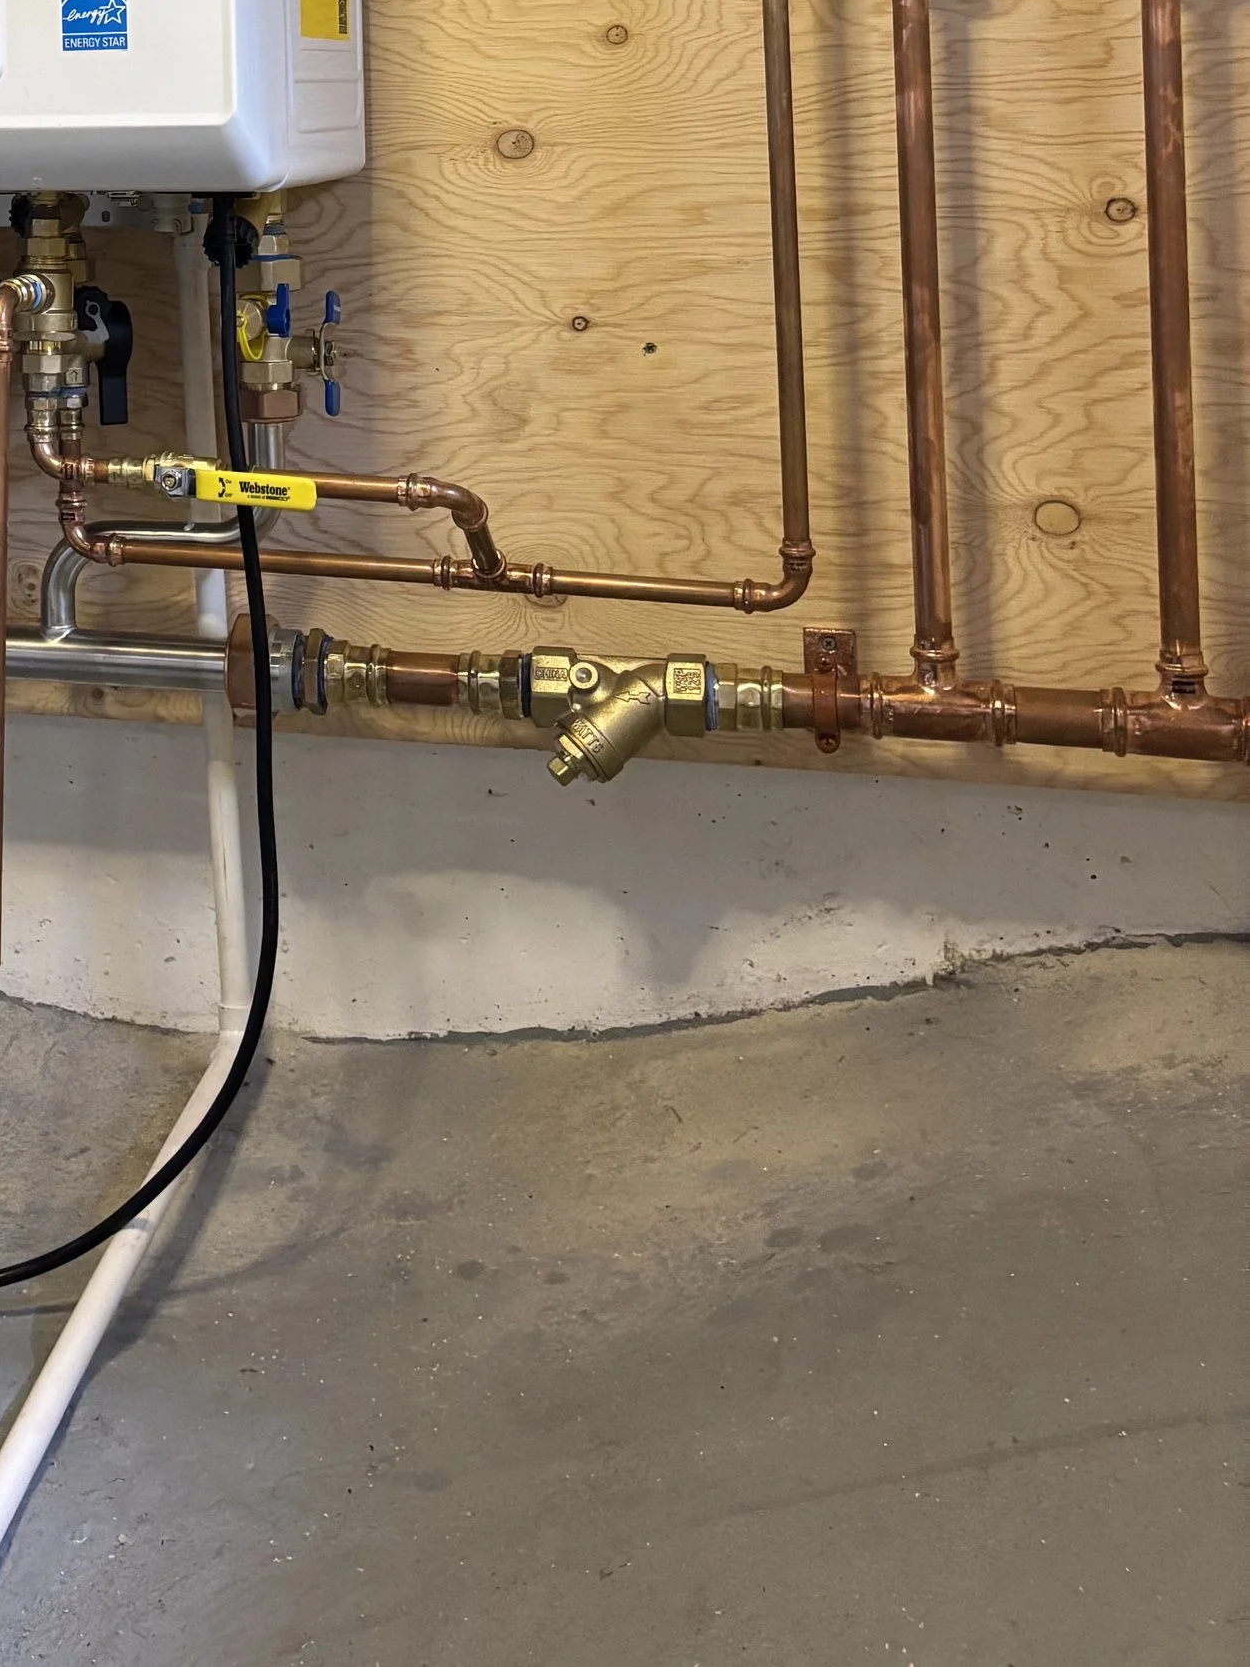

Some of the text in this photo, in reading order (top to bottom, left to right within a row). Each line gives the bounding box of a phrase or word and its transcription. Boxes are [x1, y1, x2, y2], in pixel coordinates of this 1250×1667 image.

[64, 36, 126, 49] ENERGY STAR
[239, 480, 288, 496] Webstone
